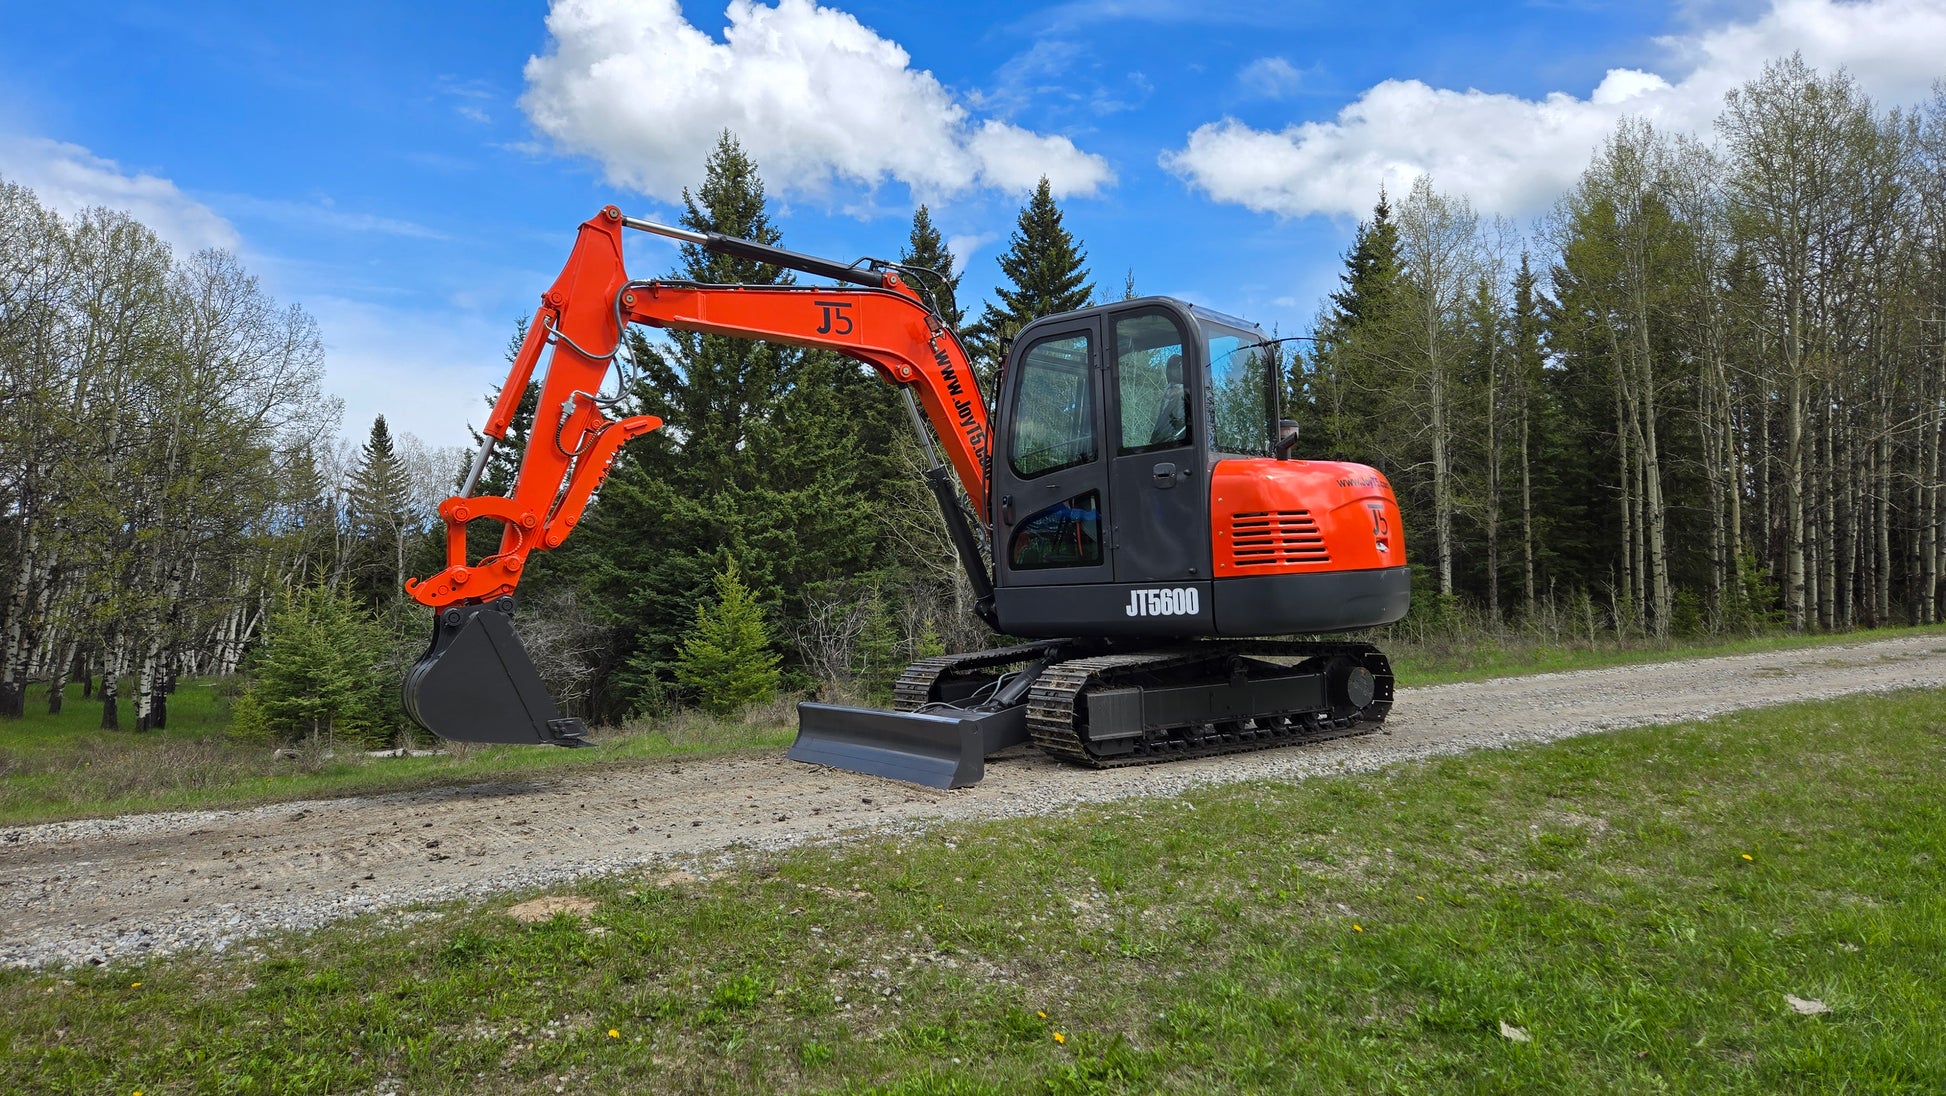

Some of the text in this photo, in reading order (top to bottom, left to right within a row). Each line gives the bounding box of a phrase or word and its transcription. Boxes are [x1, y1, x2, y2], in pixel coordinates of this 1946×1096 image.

[814, 300, 853, 335] J5
[1367, 504, 1388, 535] J5
[1126, 587, 1199, 617] JT5600
